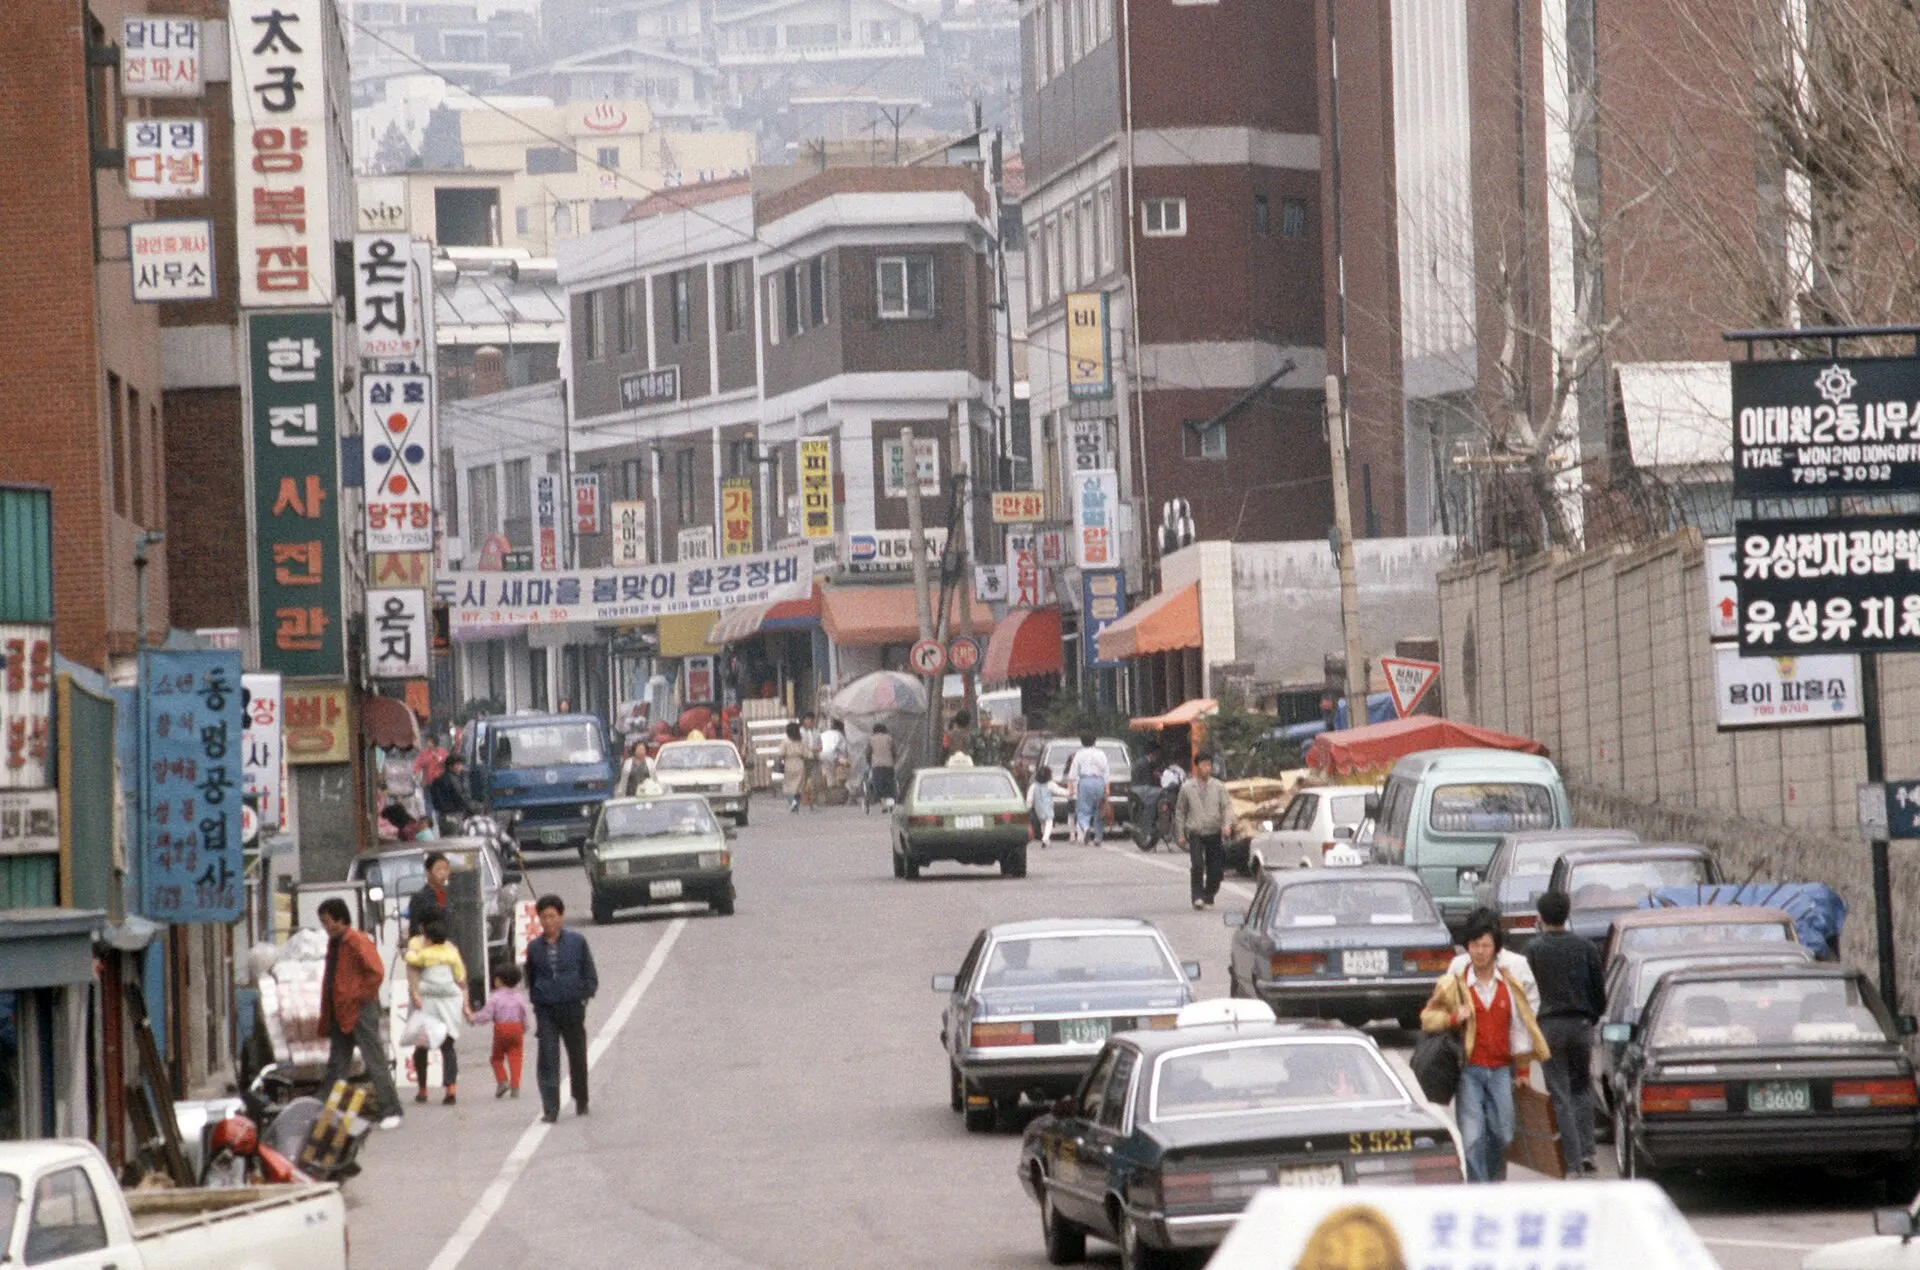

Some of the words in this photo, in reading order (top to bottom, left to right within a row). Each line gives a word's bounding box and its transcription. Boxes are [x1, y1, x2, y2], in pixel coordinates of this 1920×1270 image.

[126, 22, 196, 48] 달나라
[127, 57, 196, 82] 전파사
[128, 152, 202, 184] 다방
[252, 127, 309, 292] 양복점
[363, 202, 403, 221] vip
[138, 261, 206, 288] 사무소
[360, 239, 407, 335] 은지
[267, 337, 321, 448] 한진
[368, 503, 430, 529] 당구장
[272, 475, 330, 651] 사진관
[498, 578, 580, 607] 새마을
[593, 571, 676, 603] 봄맞이
[687, 555, 798, 597] 환경정비
[375, 597, 415, 664] 은지
[285, 696, 340, 752] 빵
